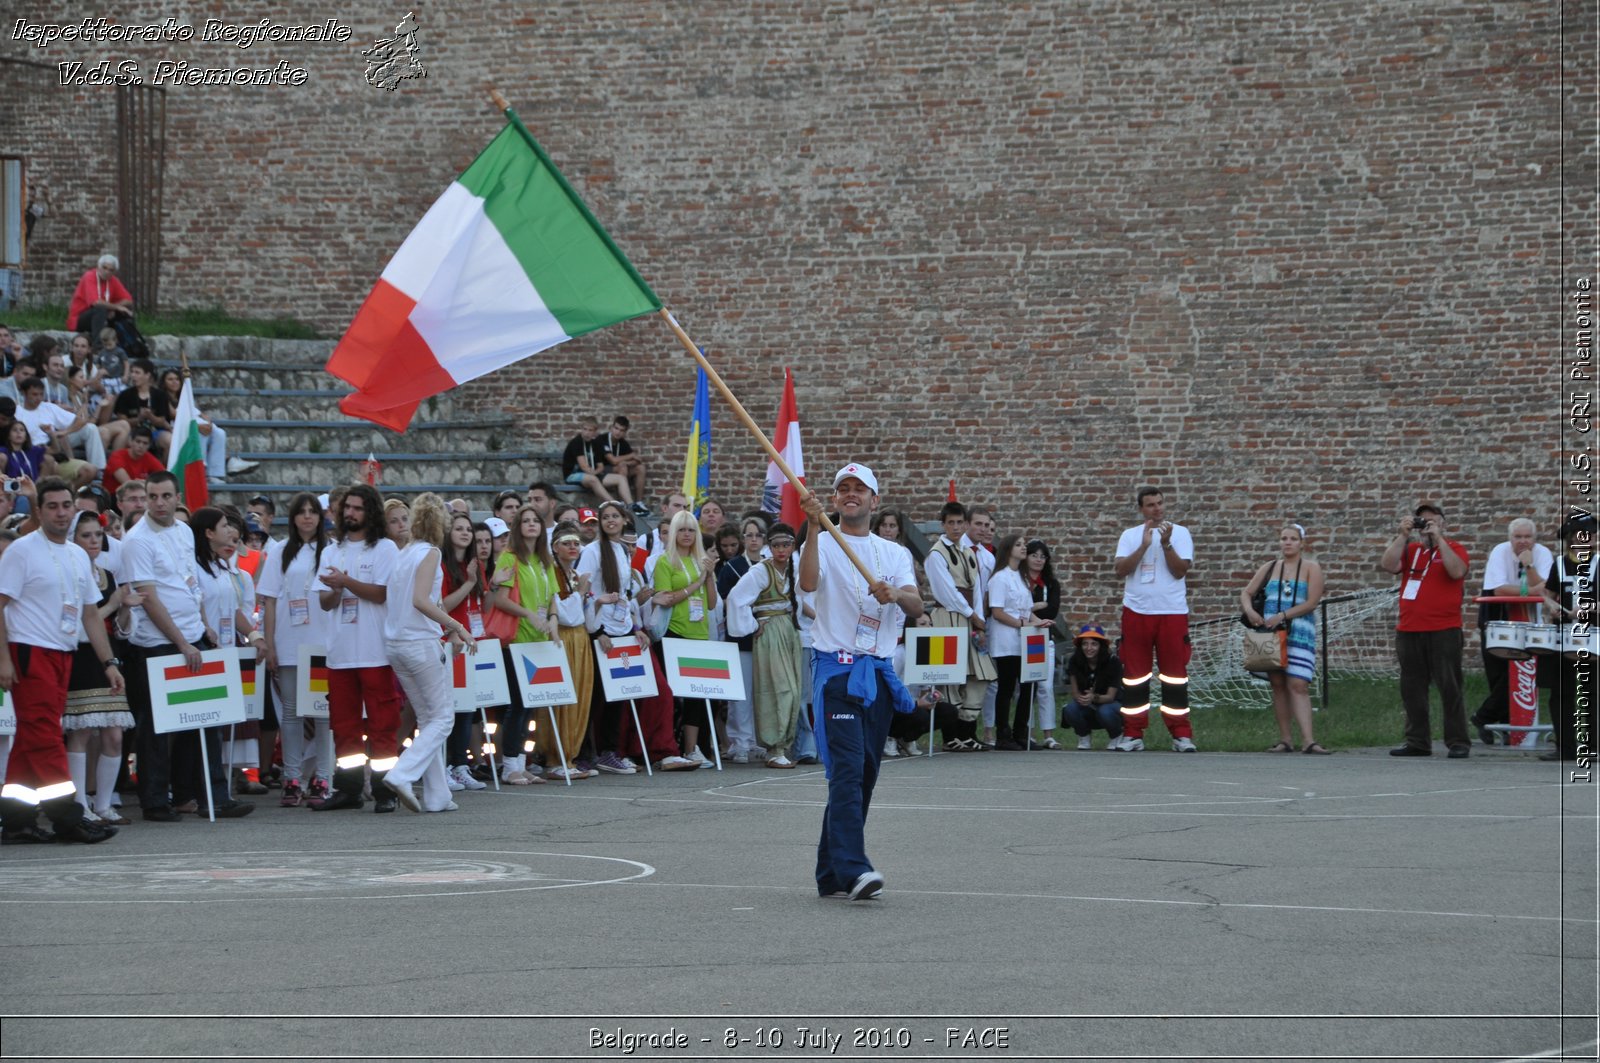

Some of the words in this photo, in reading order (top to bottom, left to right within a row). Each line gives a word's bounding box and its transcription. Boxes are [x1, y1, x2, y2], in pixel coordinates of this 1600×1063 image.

[922, 671, 949, 682] Belgium
[690, 684, 724, 695] Bulgaria
[179, 710, 222, 724] Hungary
